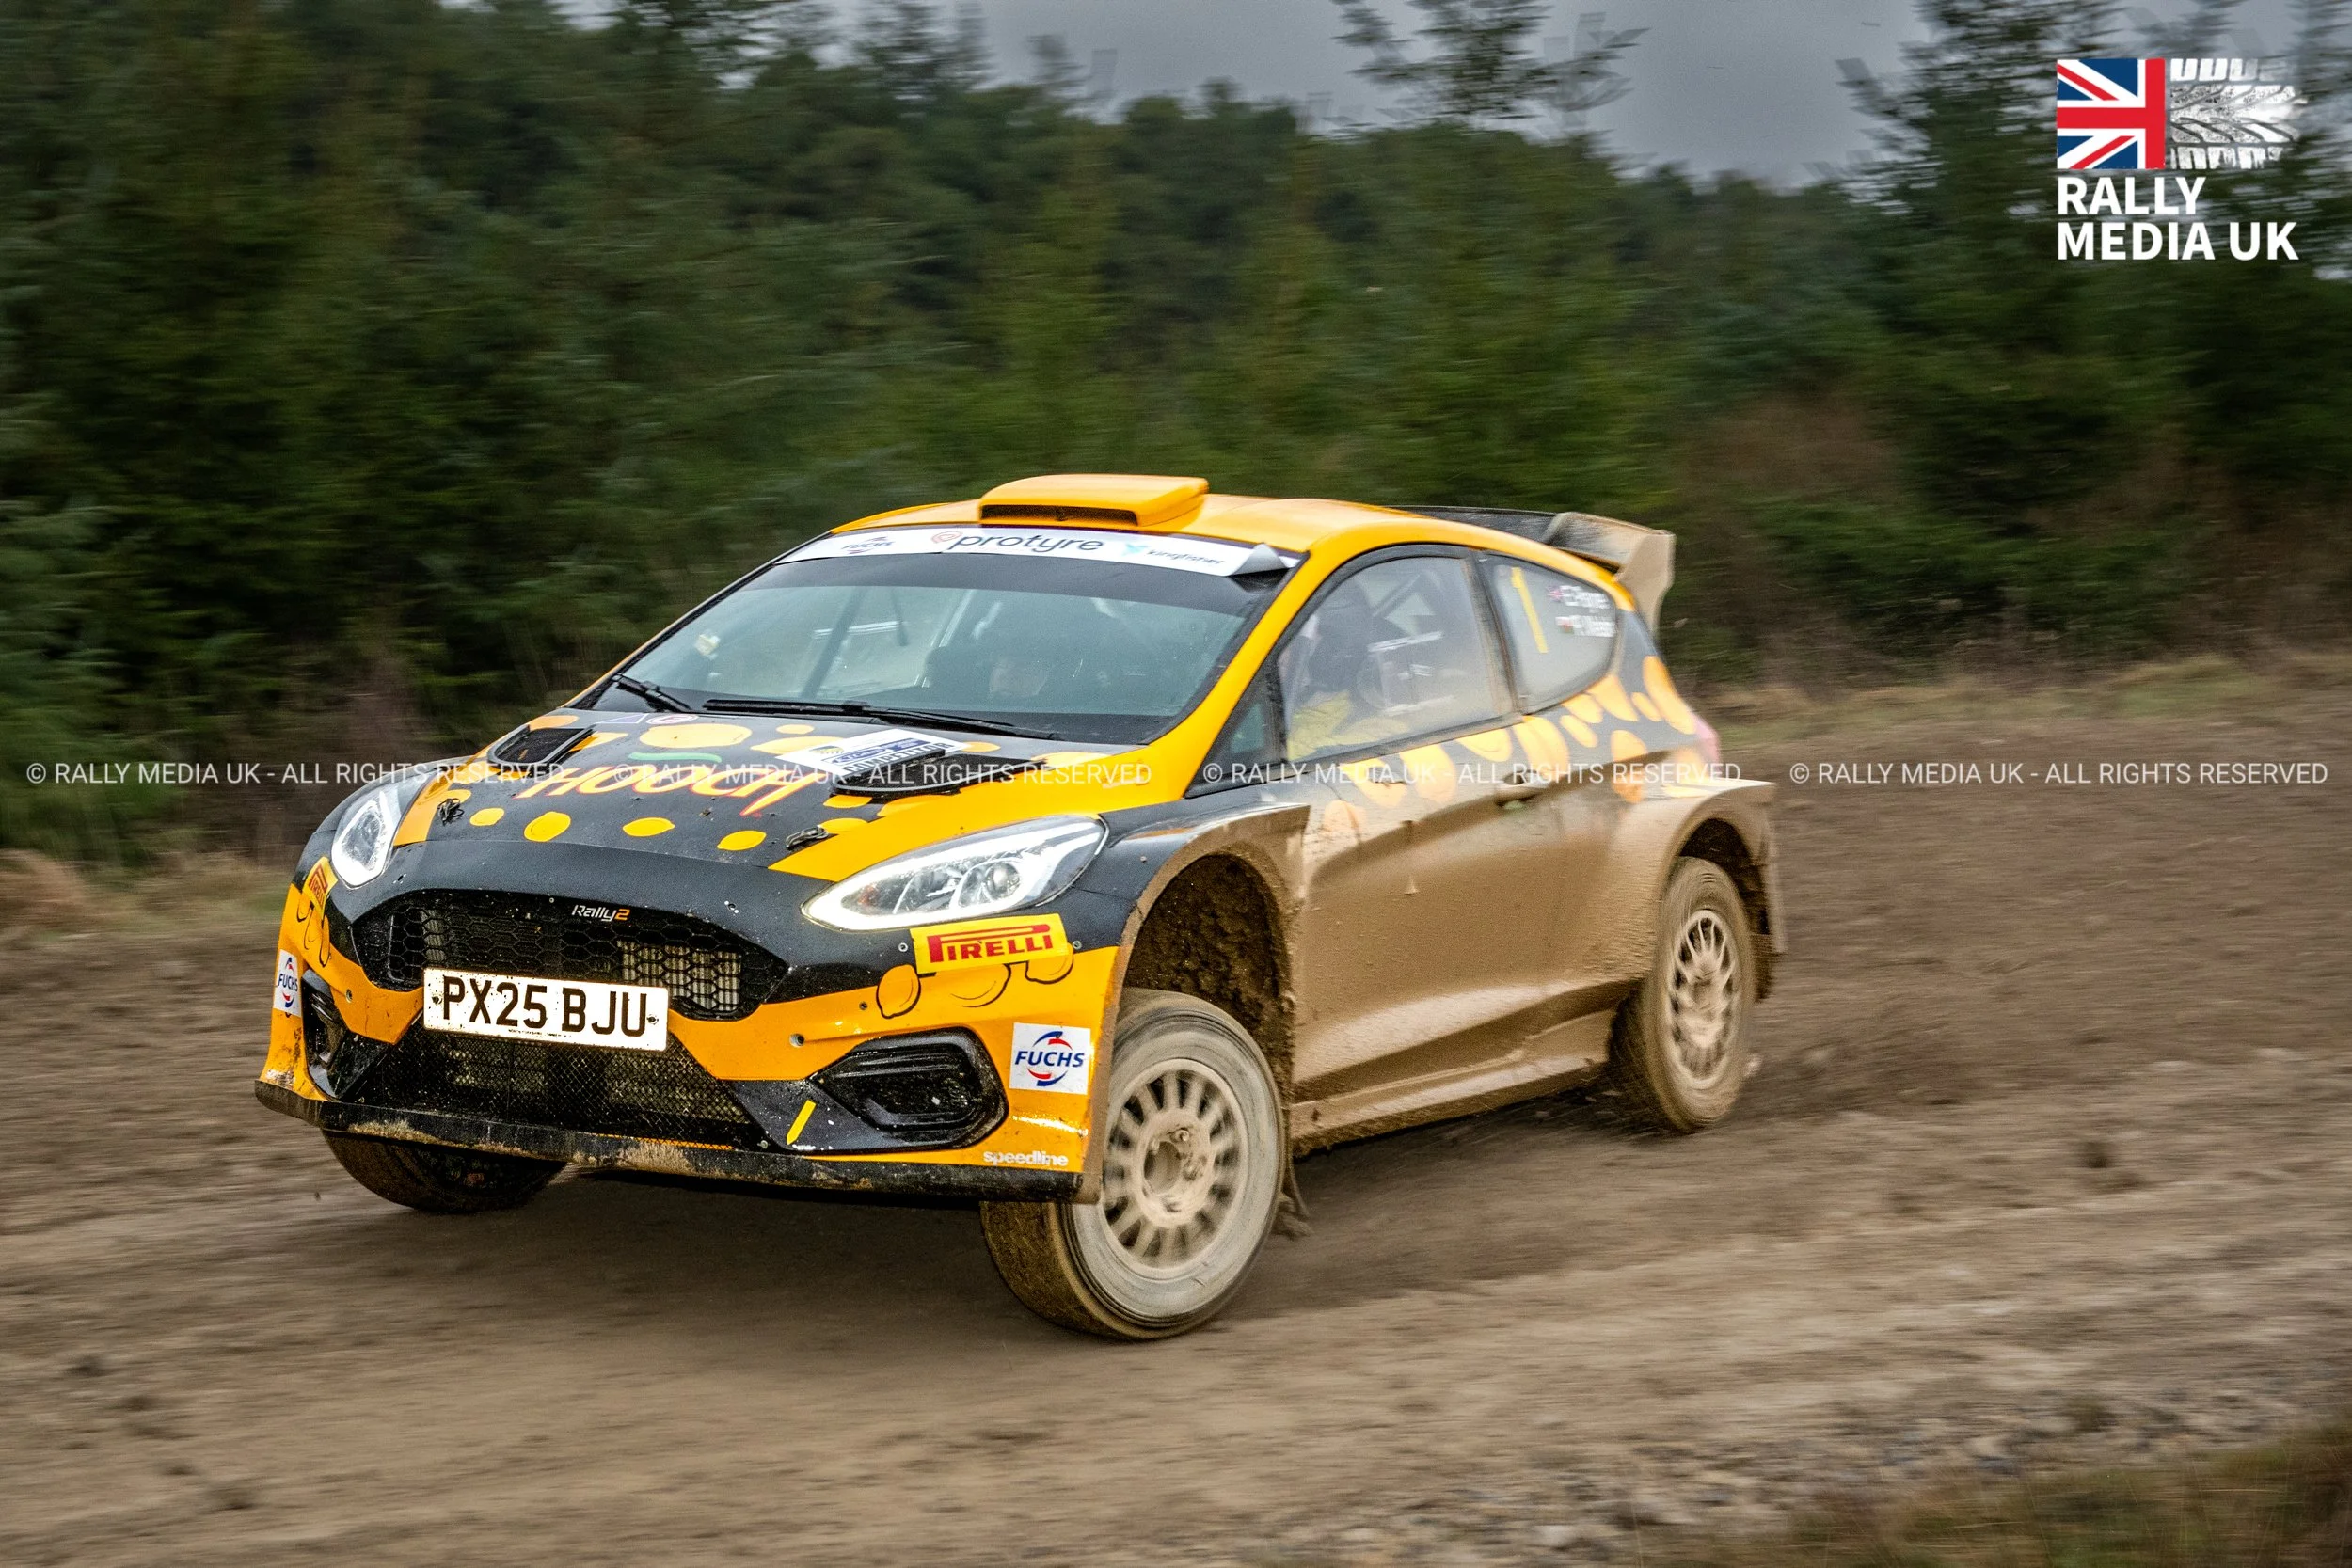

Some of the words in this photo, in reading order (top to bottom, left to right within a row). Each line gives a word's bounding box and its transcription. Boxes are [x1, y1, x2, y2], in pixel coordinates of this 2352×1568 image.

[948, 534, 1104, 553] protyre
[513, 765, 826, 816] HOOCH
[571, 904, 630, 922] Rally2
[927, 924, 1053, 963] PIRELLI
[278, 973, 298, 992] FUCHS
[442, 974, 548, 1029] PX25
[562, 987, 647, 1037] BJU
[1014, 1050, 1085, 1068] FUCHS
[983, 1149, 1069, 1167] speedline
